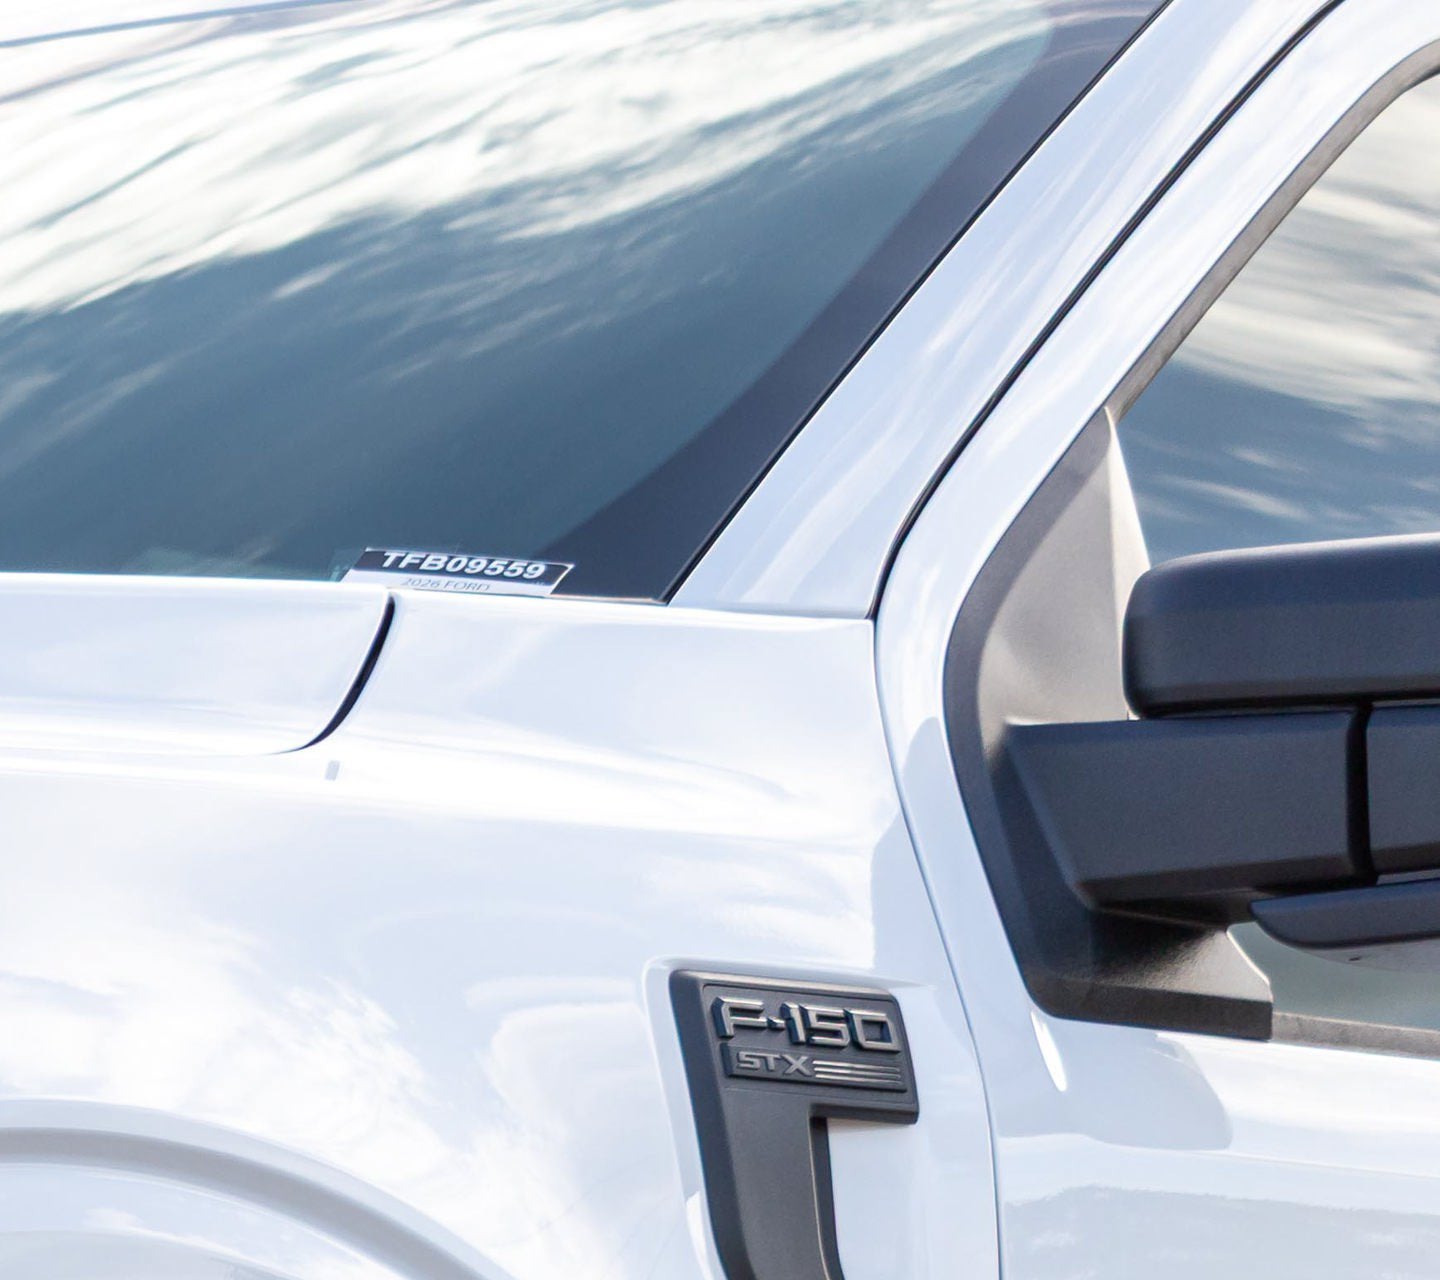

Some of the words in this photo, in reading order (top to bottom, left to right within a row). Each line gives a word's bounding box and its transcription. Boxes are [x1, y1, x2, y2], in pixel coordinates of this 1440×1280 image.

[382, 551, 547, 579] TFB09559
[401, 577, 441, 589] 2026
[444, 580, 491, 592] FORD
[711, 996, 900, 1052] F-150
[736, 1051, 813, 1077] STX
